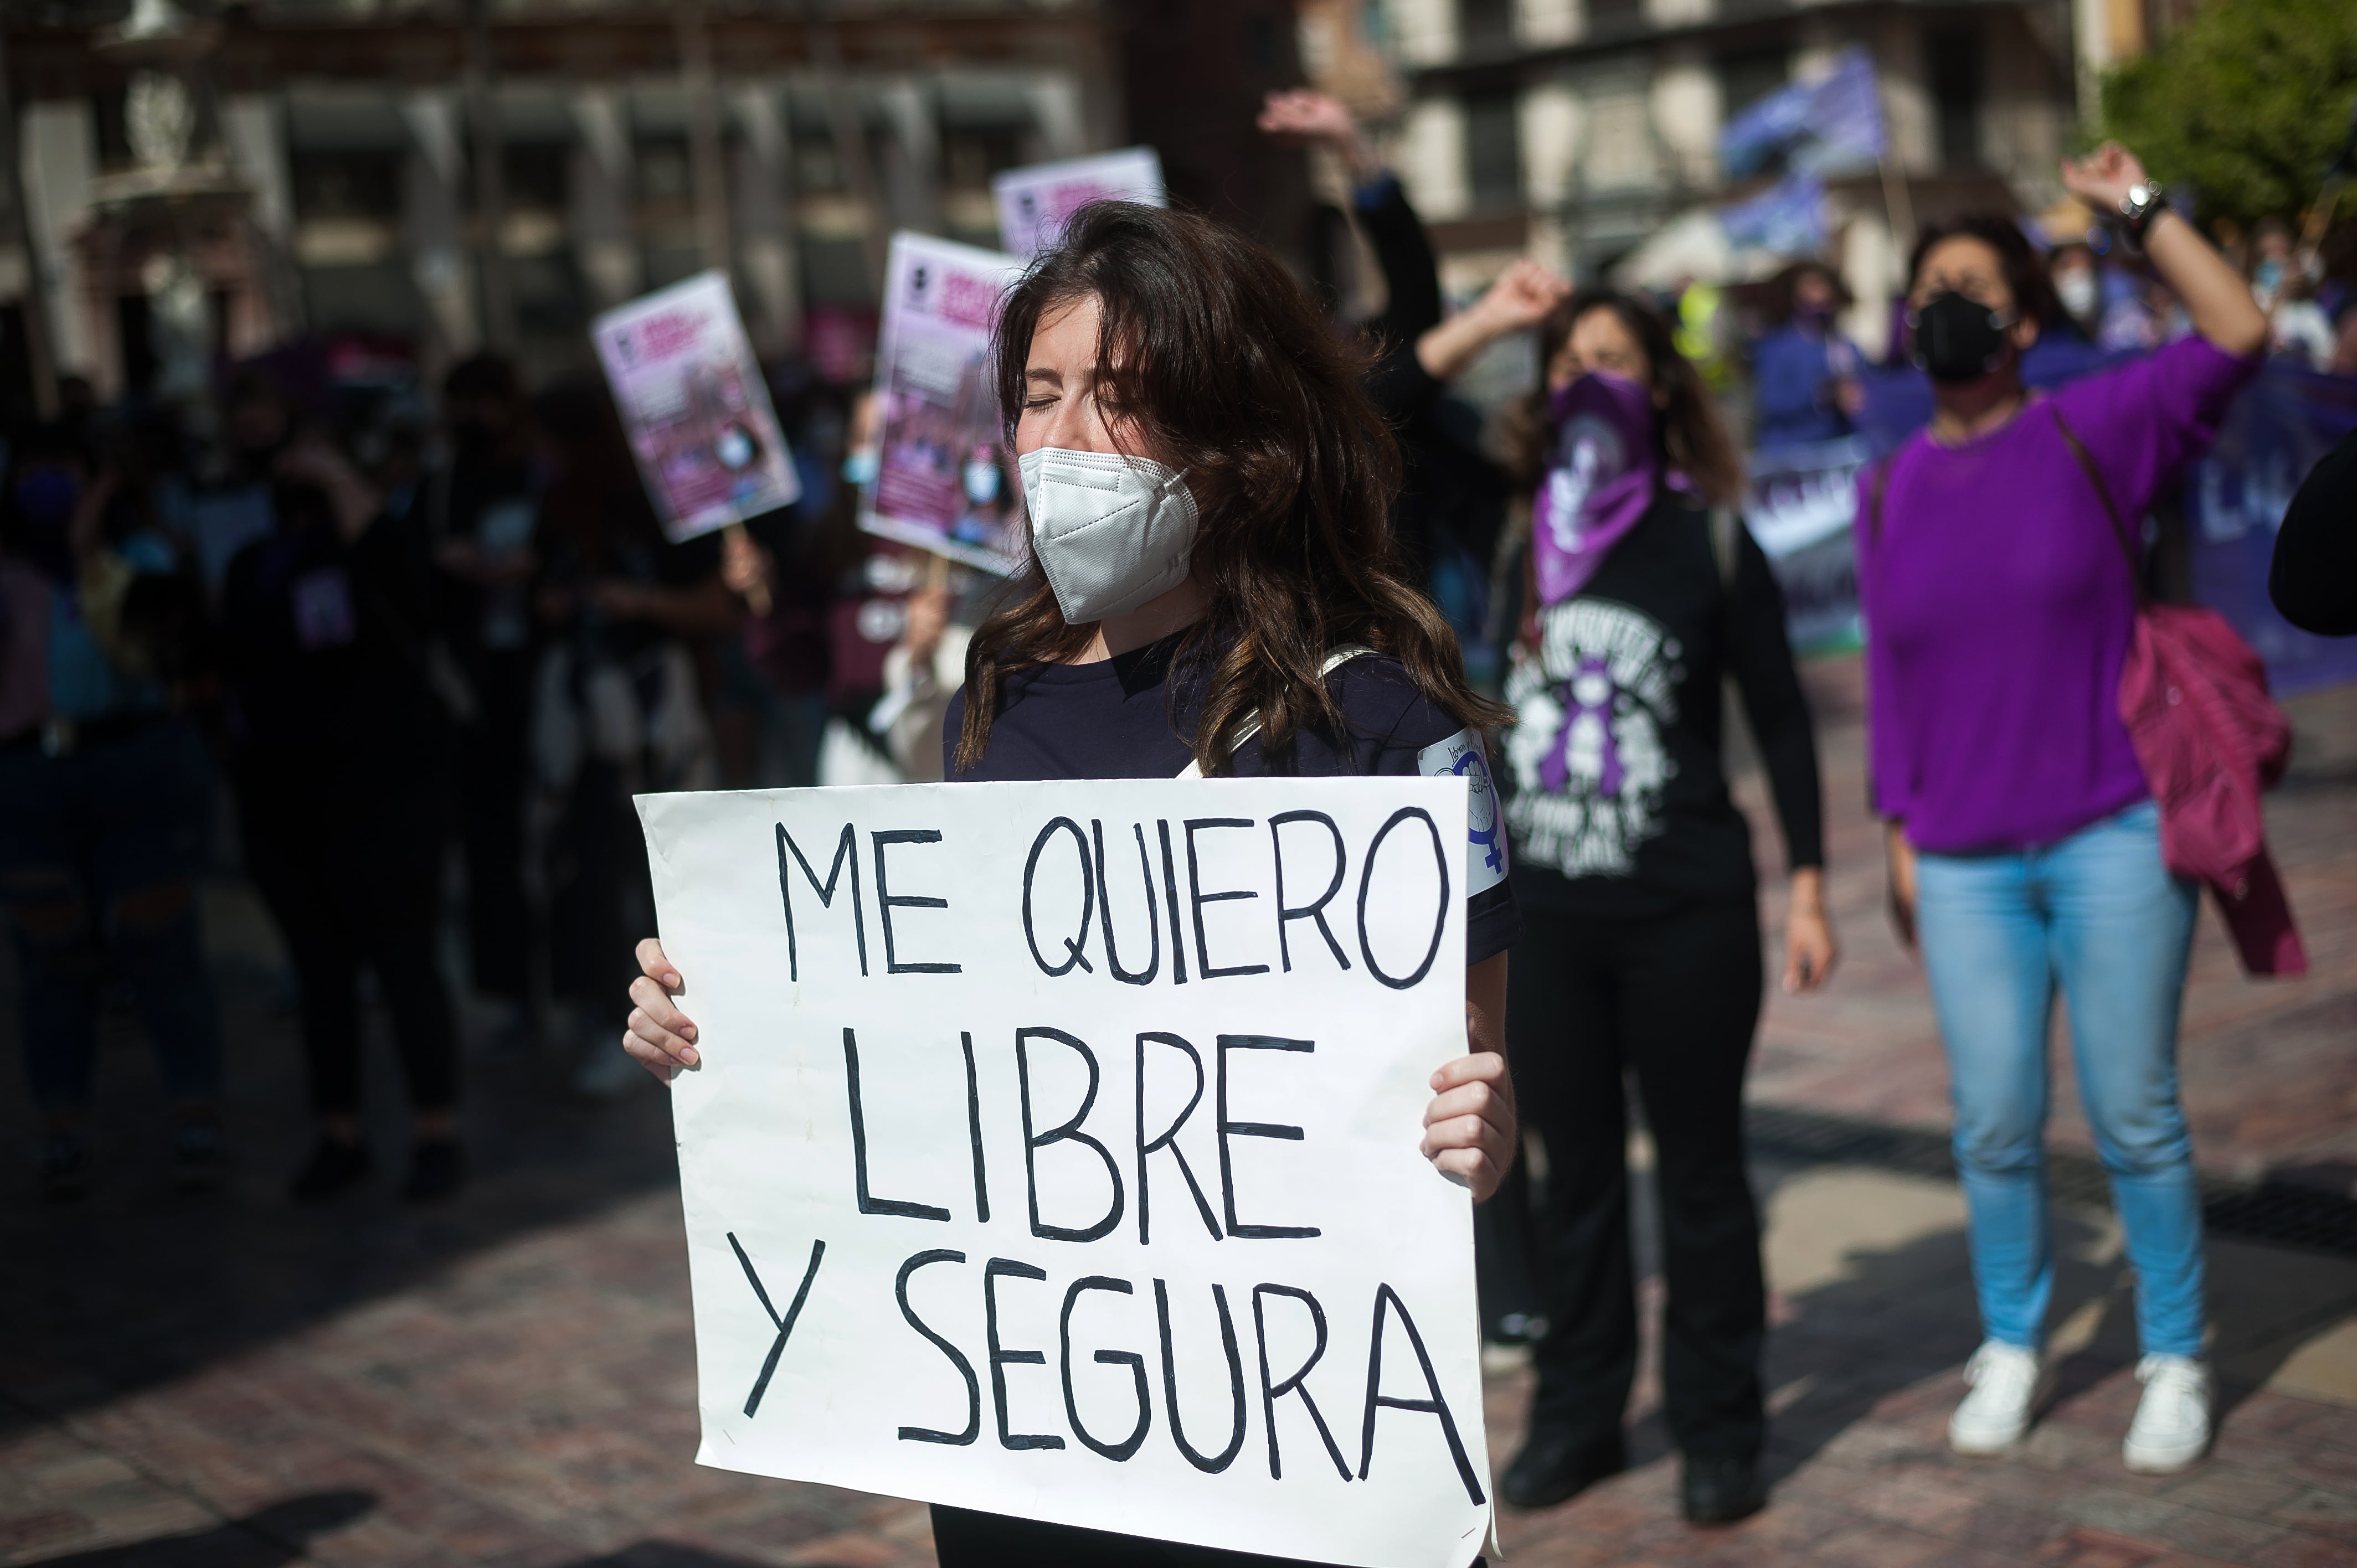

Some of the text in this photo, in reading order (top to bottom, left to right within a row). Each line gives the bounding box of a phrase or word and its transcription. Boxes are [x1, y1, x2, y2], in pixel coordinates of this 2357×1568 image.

[1447, 742, 1466, 768] Libres
[775, 821, 963, 982] ME
[1022, 806, 1450, 990] QUIERO
[843, 1027, 1321, 1246] LIBRE
[726, 1231, 1486, 1507] Y SEGURA
